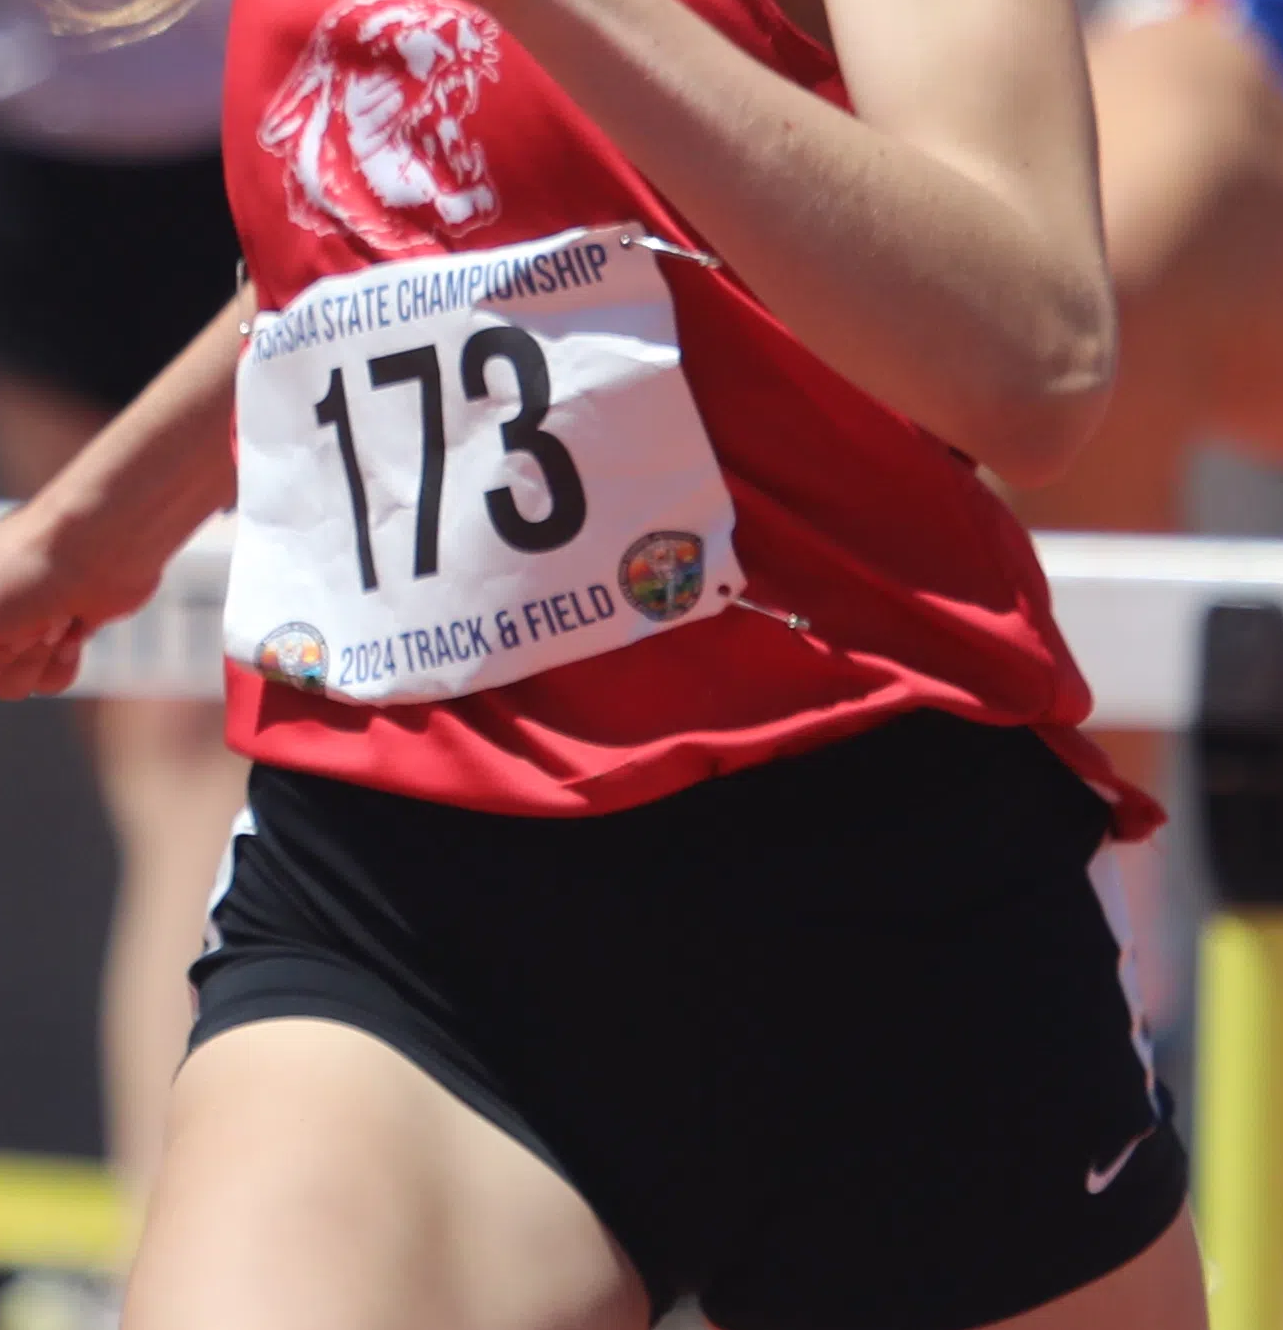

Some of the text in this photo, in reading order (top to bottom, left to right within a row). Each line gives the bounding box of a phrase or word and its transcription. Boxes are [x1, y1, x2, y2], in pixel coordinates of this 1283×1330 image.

[321, 283, 391, 342] STATE
[396, 243, 607, 323] CHAMPIONSHIP
[314, 325, 588, 594] 173
[338, 641, 396, 687] 2024
[400, 621, 494, 678] TRACK
[495, 613, 523, 649] &
[524, 583, 616, 644] FIELD
